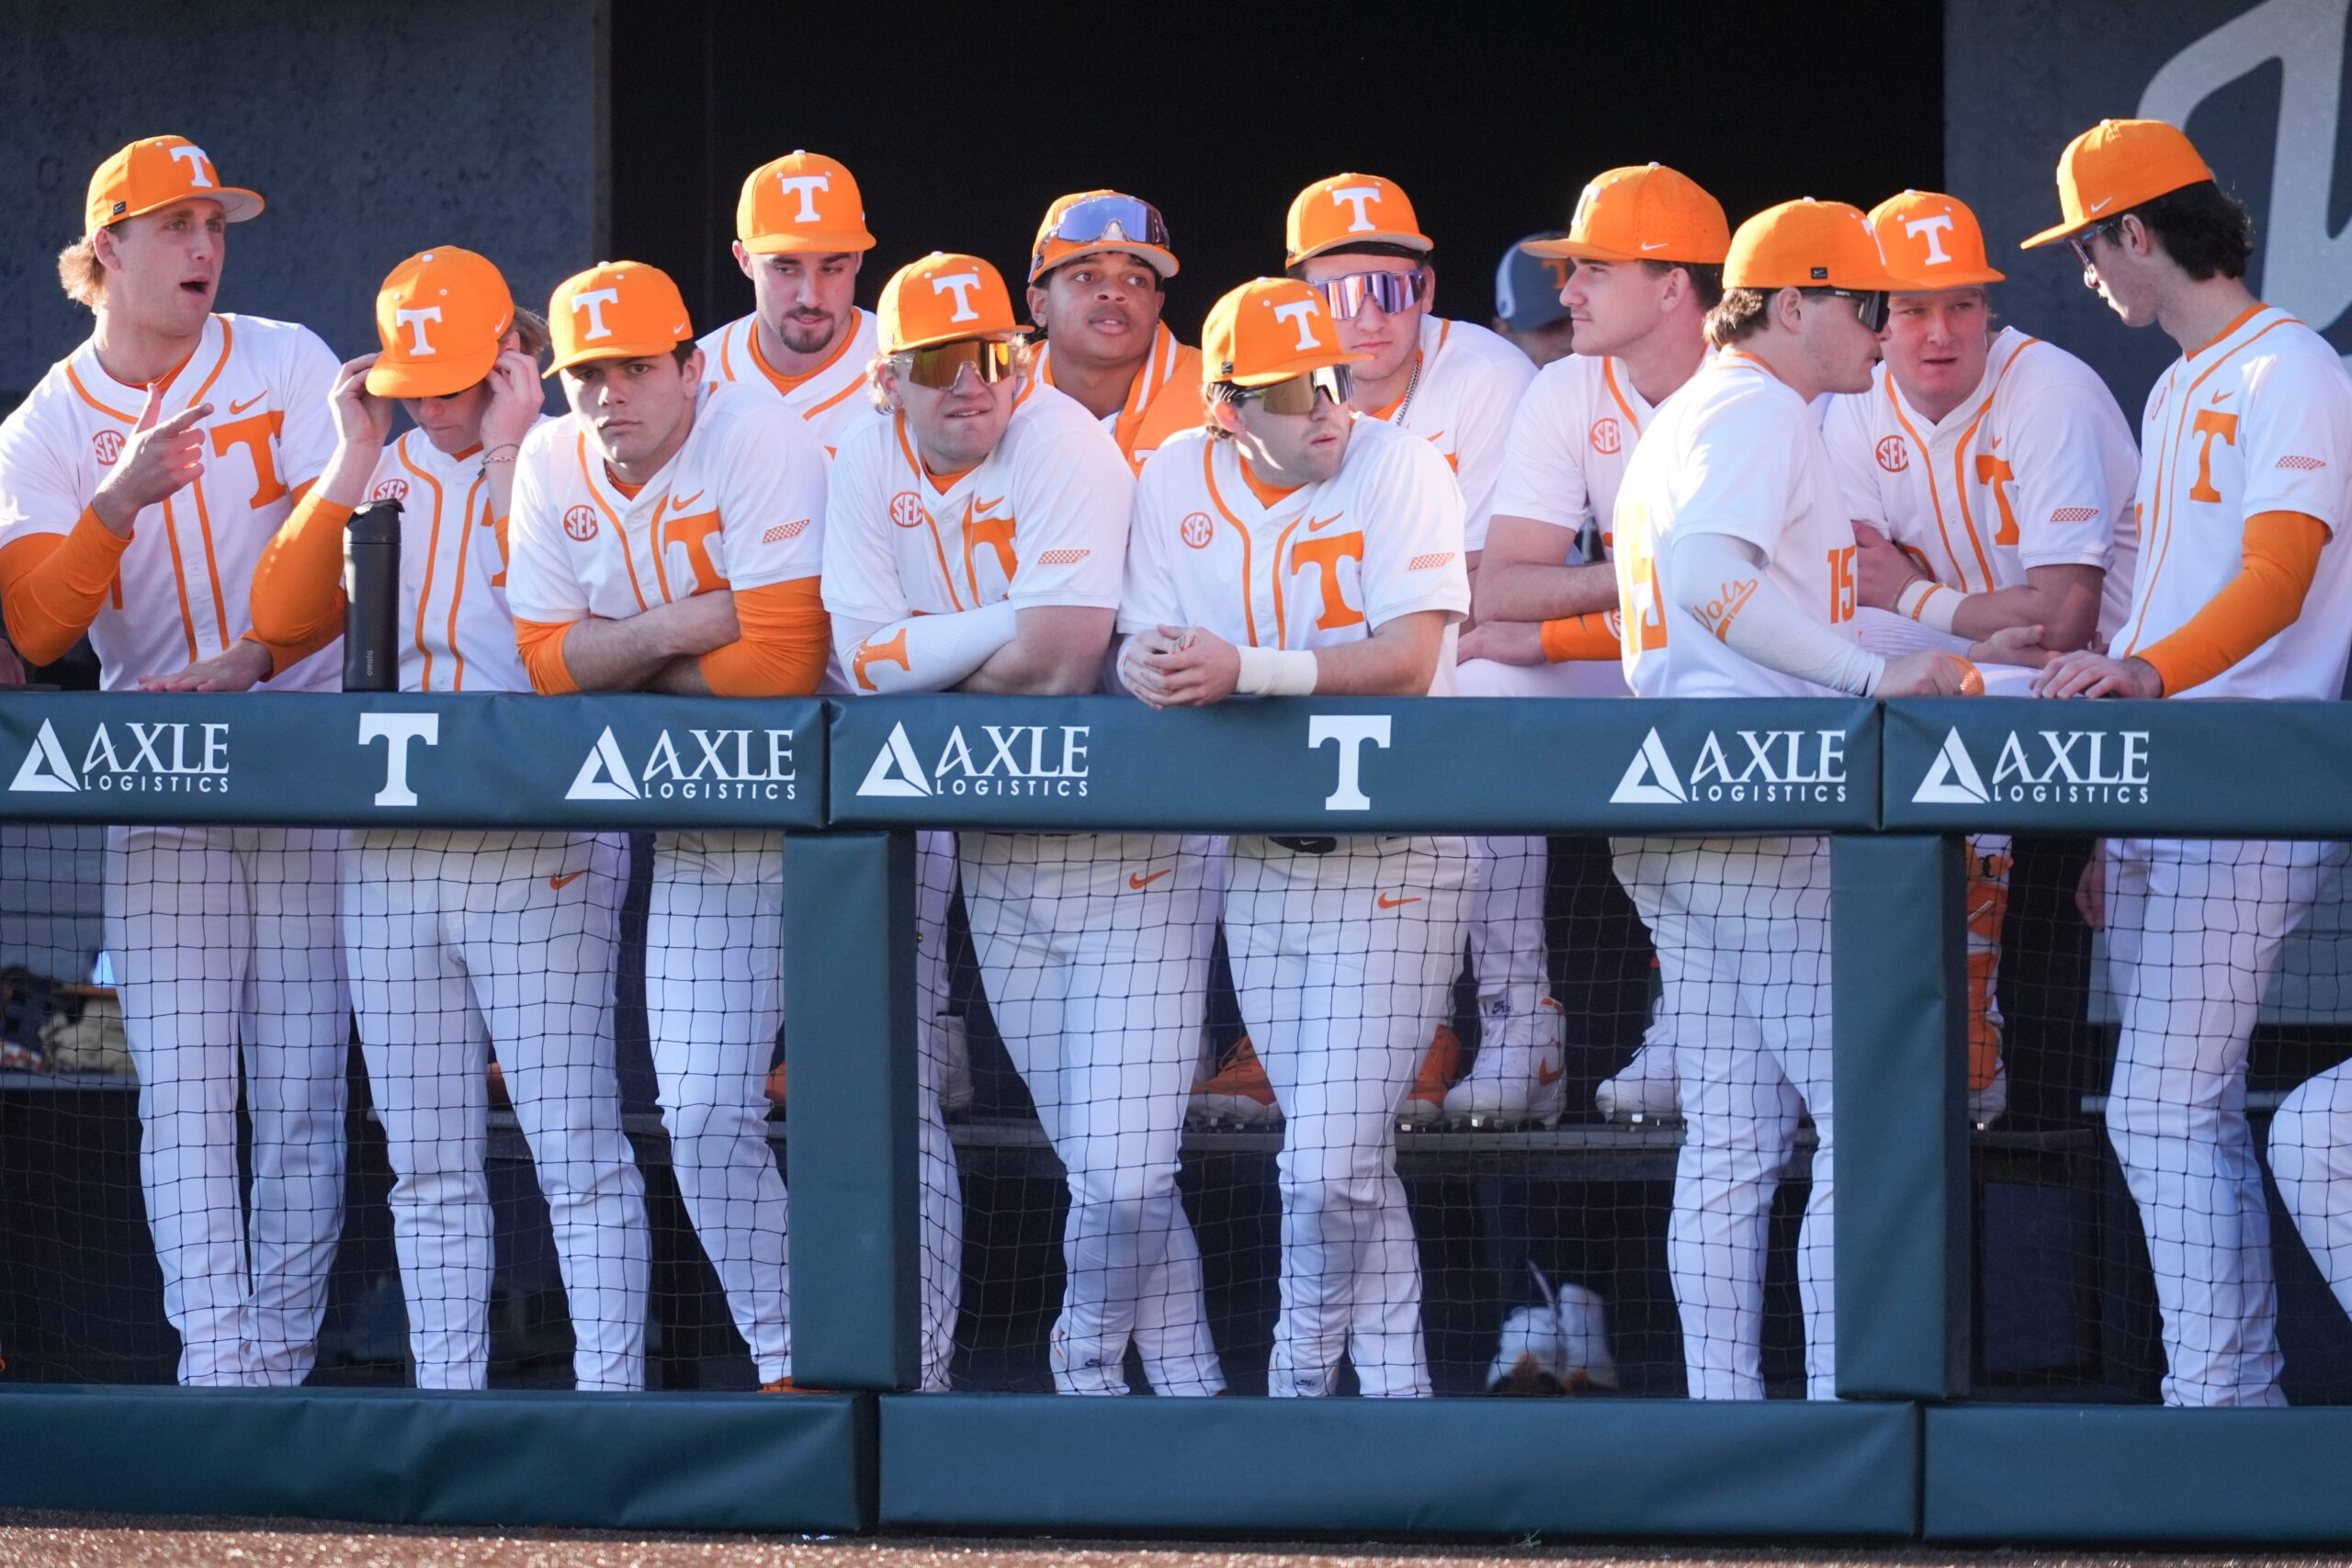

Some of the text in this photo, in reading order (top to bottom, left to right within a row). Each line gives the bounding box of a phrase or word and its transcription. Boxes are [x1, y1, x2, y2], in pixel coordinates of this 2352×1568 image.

[169, 145, 213, 187] T
[782, 175, 830, 223] T
[1332, 186, 1382, 232] T
[1906, 214, 1953, 265] T
[571, 288, 619, 340] T
[933, 272, 981, 322] T
[396, 306, 442, 356] T
[1273, 299, 1320, 351] T
[209, 411, 286, 510] T
[1876, 435, 1909, 472] SEC
[2190, 410, 2239, 503] T
[564, 505, 598, 542] SEC
[889, 491, 923, 527] SEC
[1975, 455, 2021, 546] T
[664, 508, 731, 597] T
[1181, 512, 1213, 549] SEC
[1292, 531, 1365, 631] T
[1827, 544, 1856, 624] 15
[366, 649, 374, 677] owala
[853, 628, 910, 691] T
[83, 723, 229, 774] AXLE
[358, 713, 439, 807] T
[643, 729, 796, 781] AXLE
[934, 725, 1090, 778] AXLE
[1308, 715, 1392, 810] T
[1690, 729, 1847, 784] AXLE
[1992, 730, 2150, 784] AXLE
[85, 774, 229, 793] LOGISTICS
[644, 782, 796, 800] LOGISTICS
[936, 779, 1088, 797] LOGISTICS
[1691, 784, 1846, 803] LOGISTICS
[1994, 784, 2148, 804] LOGISTICS
